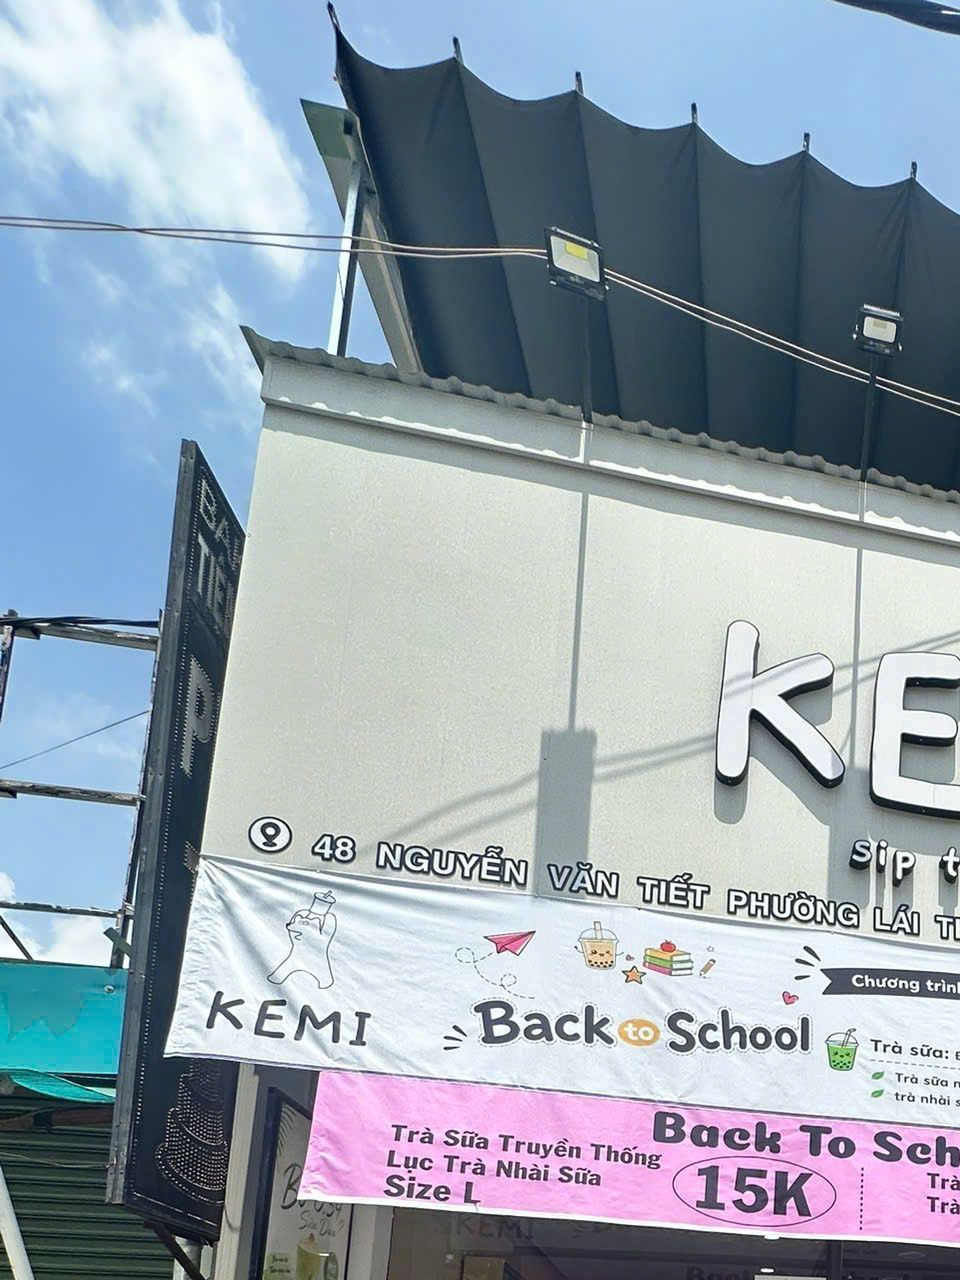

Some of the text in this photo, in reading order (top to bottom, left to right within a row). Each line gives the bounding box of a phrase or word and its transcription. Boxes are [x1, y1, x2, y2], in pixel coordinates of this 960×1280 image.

[850, 840, 917, 886] sip
[311, 833, 356, 863] 48
[376, 842, 528, 885] NGUYỄN
[547, 862, 619, 899] VĂN
[636, 873, 711, 910] TIẾT
[727, 891, 860, 928] PHƯỜNG
[873, 905, 921, 936] LÁI
[850, 973, 921, 995] Chương
[206, 990, 371, 1047] KEMI
[473, 1000, 810, 1053] Back to School
[870, 1038, 903, 1055] Trà
[910, 1043, 950, 1060] sữa:
[894, 1071, 919, 1085] Trà
[923, 1074, 949, 1088] sữa
[894, 1091, 916, 1103] trà
[920, 1092, 951, 1106] nhài
[391, 1123, 662, 1170] Trà Sữa Truyền Thống
[653, 1111, 781, 1154] Back
[799, 1124, 857, 1159] To
[386, 1150, 601, 1187] Lục Trà Nhài Sữa
[926, 1172, 960, 1191] Trà
[383, 1174, 481, 1204] Size L
[695, 1164, 814, 1218] 15K
[926, 1196, 960, 1215] Trà
